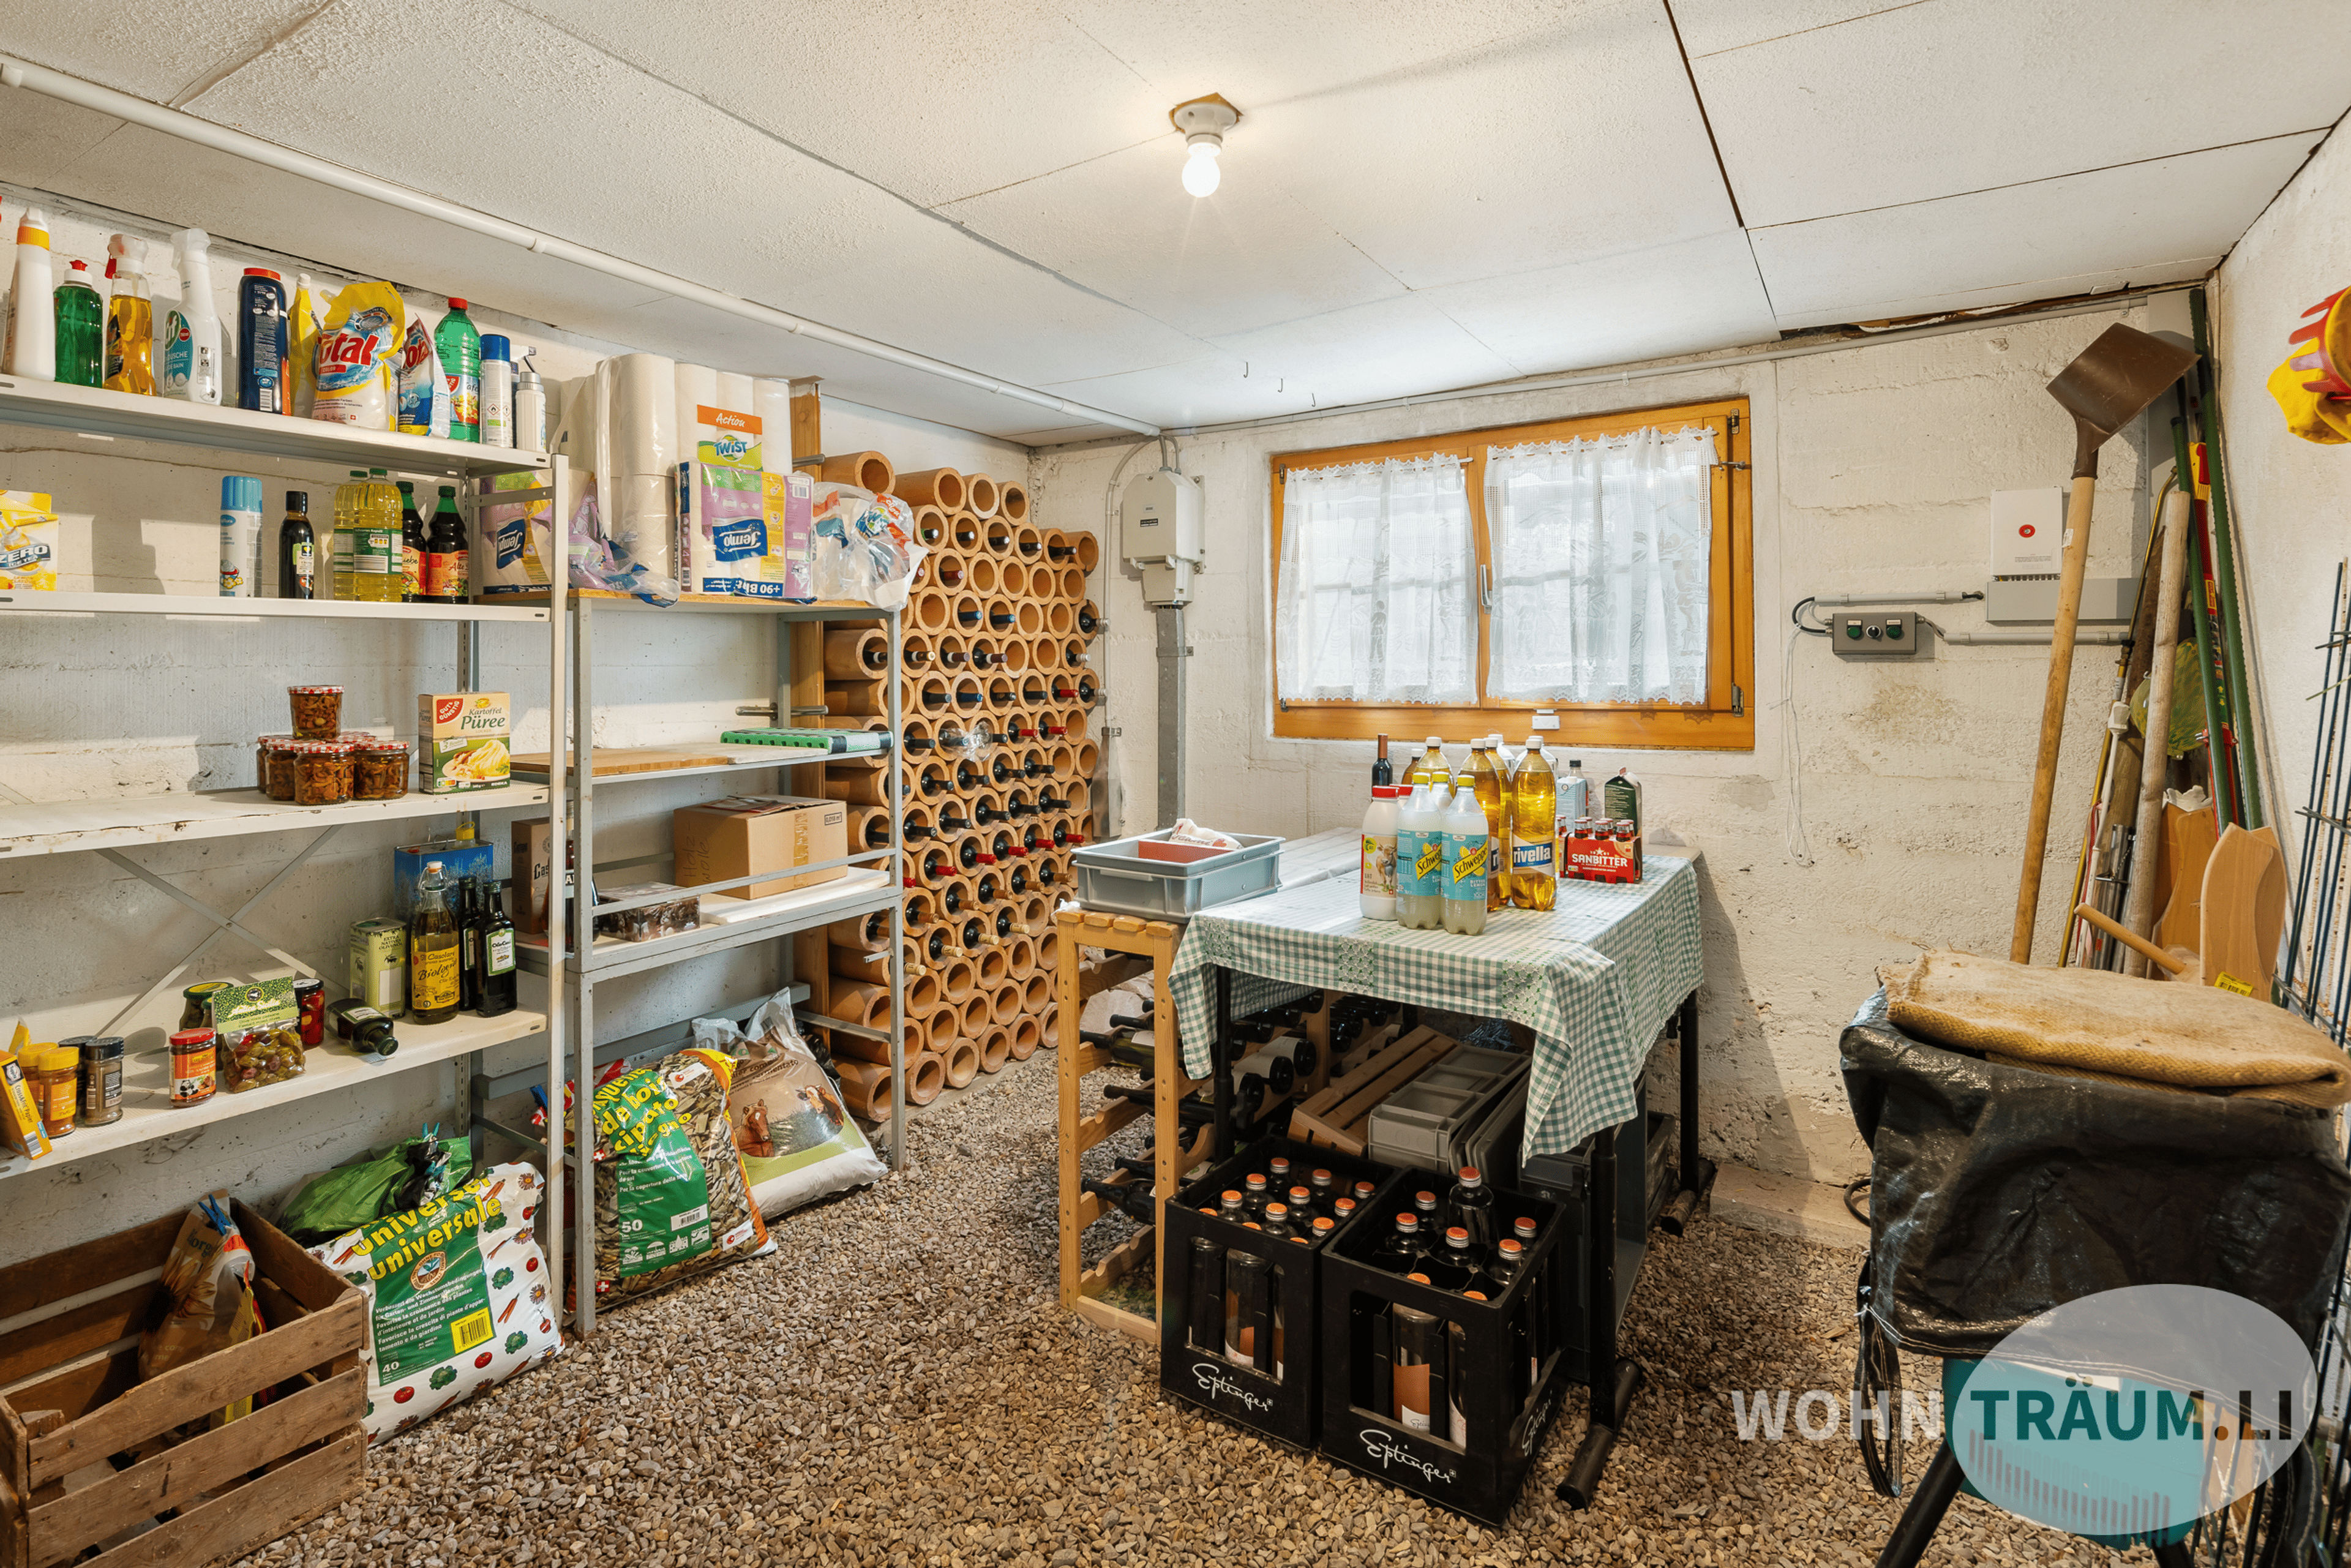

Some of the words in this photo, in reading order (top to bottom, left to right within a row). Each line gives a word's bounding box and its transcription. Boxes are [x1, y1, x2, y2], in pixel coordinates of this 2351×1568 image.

[716, 413, 745, 427] Action
[724, 531, 761, 547] Tempo
[0, 546, 48, 563] ZERO
[439, 700, 460, 721] GÜNSTIG
[461, 716, 506, 730] Püree
[442, 742, 449, 751] 3
[1454, 847, 1487, 878] Schweppe
[1513, 846, 1551, 863] rivella
[1572, 853, 1628, 867] SANBITTER
[534, 863, 549, 880] Cas
[621, 1219, 643, 1233] 50
[367, 1195, 502, 1281] universale
[453, 1287, 473, 1300] plantes
[427, 1307, 445, 1318] jardin
[378, 1330, 407, 1345] Favorisce
[446, 1307, 463, 1320] piante
[418, 1324, 443, 1338] giardino
[382, 1361, 400, 1373] 40
[1192, 1363, 1269, 1412] Eptinger
[1359, 1429, 1452, 1484] Eptinger
